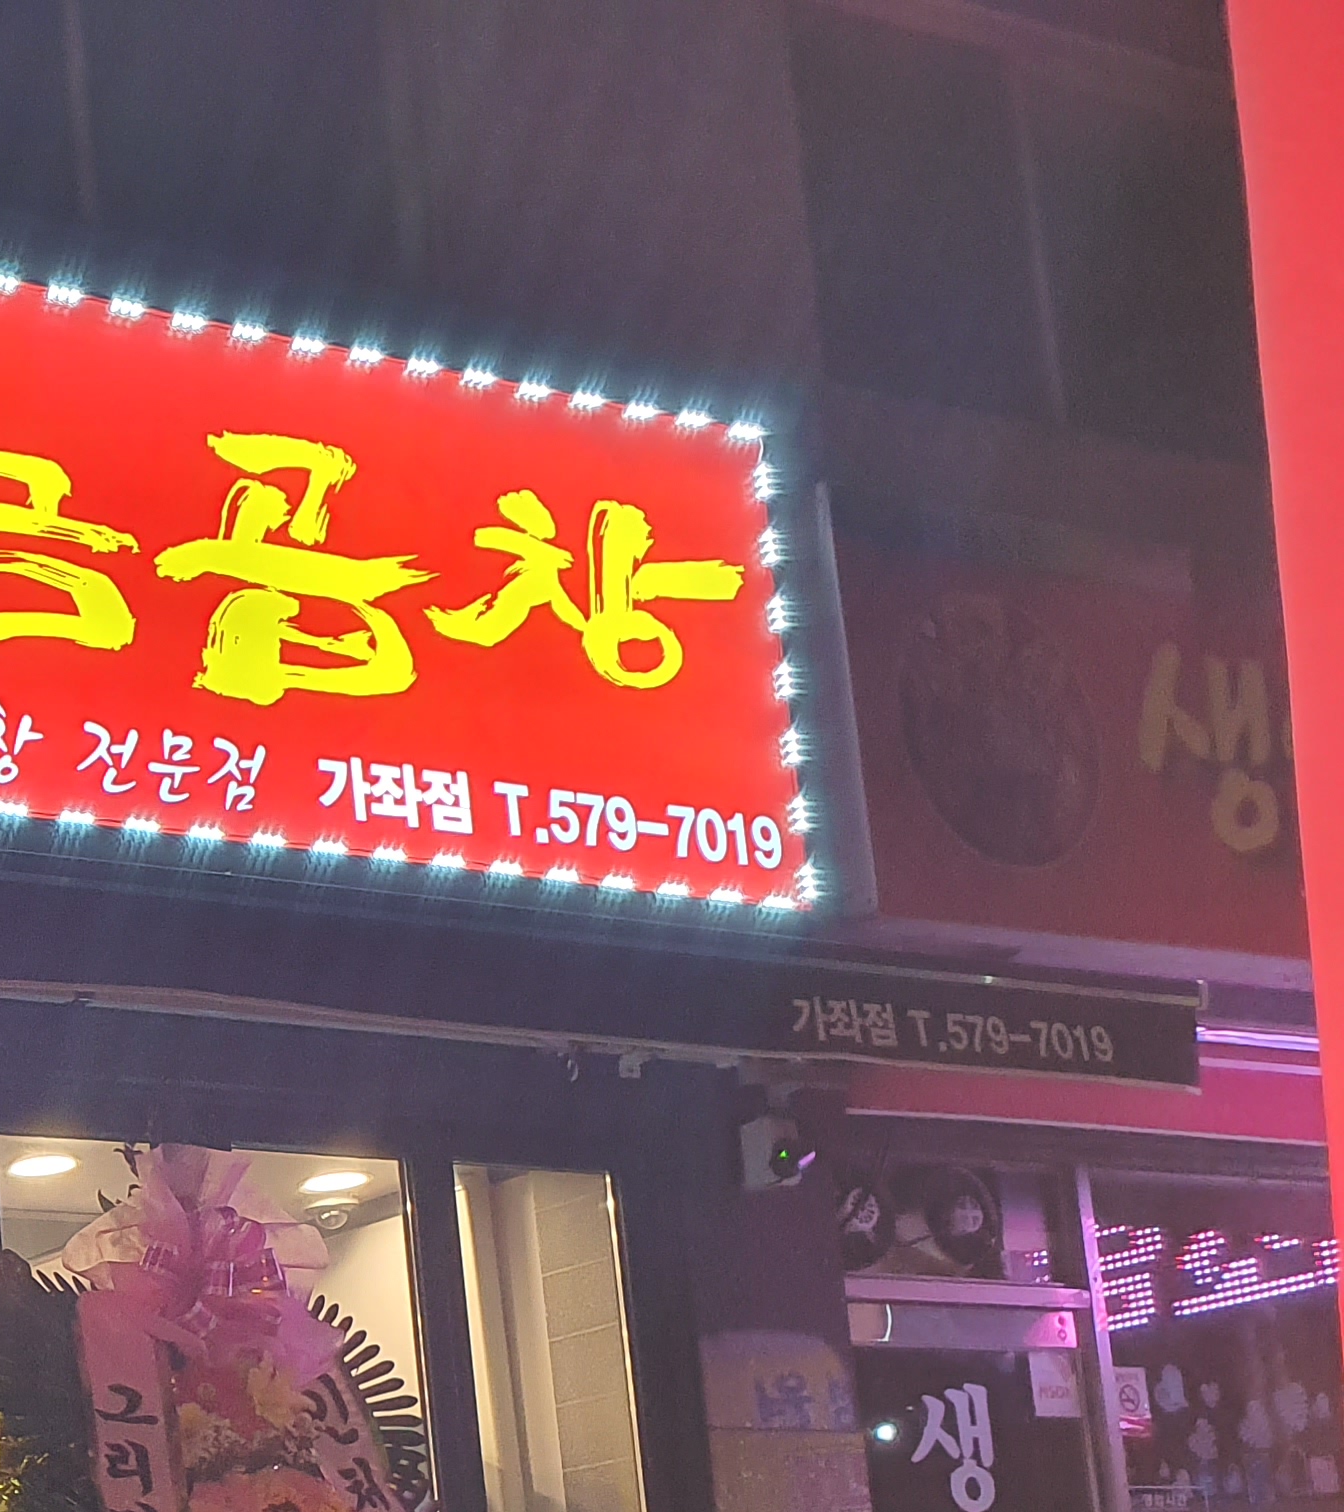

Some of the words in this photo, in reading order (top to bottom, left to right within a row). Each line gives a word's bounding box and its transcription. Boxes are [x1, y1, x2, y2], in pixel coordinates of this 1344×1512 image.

[74, 719, 266, 812] 전문점
[318, 756, 475, 835] 가좌점
[493, 779, 782, 869] T.579-7019
[792, 999, 896, 1047] 가좌점
[907, 1008, 1114, 1062] T.579-7019
